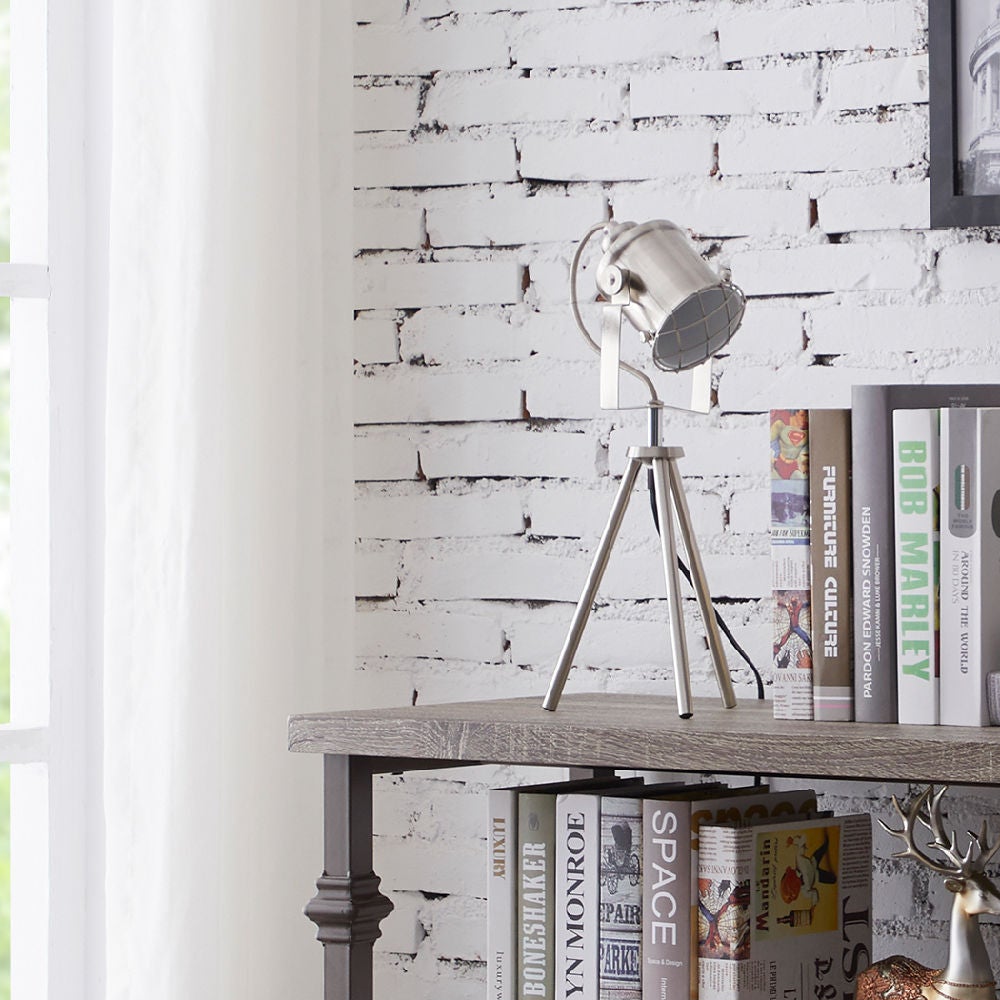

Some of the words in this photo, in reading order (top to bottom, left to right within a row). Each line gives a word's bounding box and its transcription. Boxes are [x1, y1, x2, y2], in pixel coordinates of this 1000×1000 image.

[898, 441, 929, 515] BOB
[822, 465, 838, 568] FURNITURE
[861, 506, 871, 577] SNOWDEN
[862, 580, 872, 639] EDWARD
[900, 533, 930, 682] MARLEY
[960, 551, 969, 601] AROUND
[824, 576, 838, 658] CULTURE
[960, 605, 969, 629] THE
[960, 632, 969, 674] WORLD
[862, 643, 873, 699] PARDON
[493, 817, 506, 880] LUXURY
[566, 812, 585, 950] MONROE
[651, 809, 678, 946] SPACE
[756, 838, 771, 932] Mandarin
[522, 842, 546, 998] BONESHAKER
